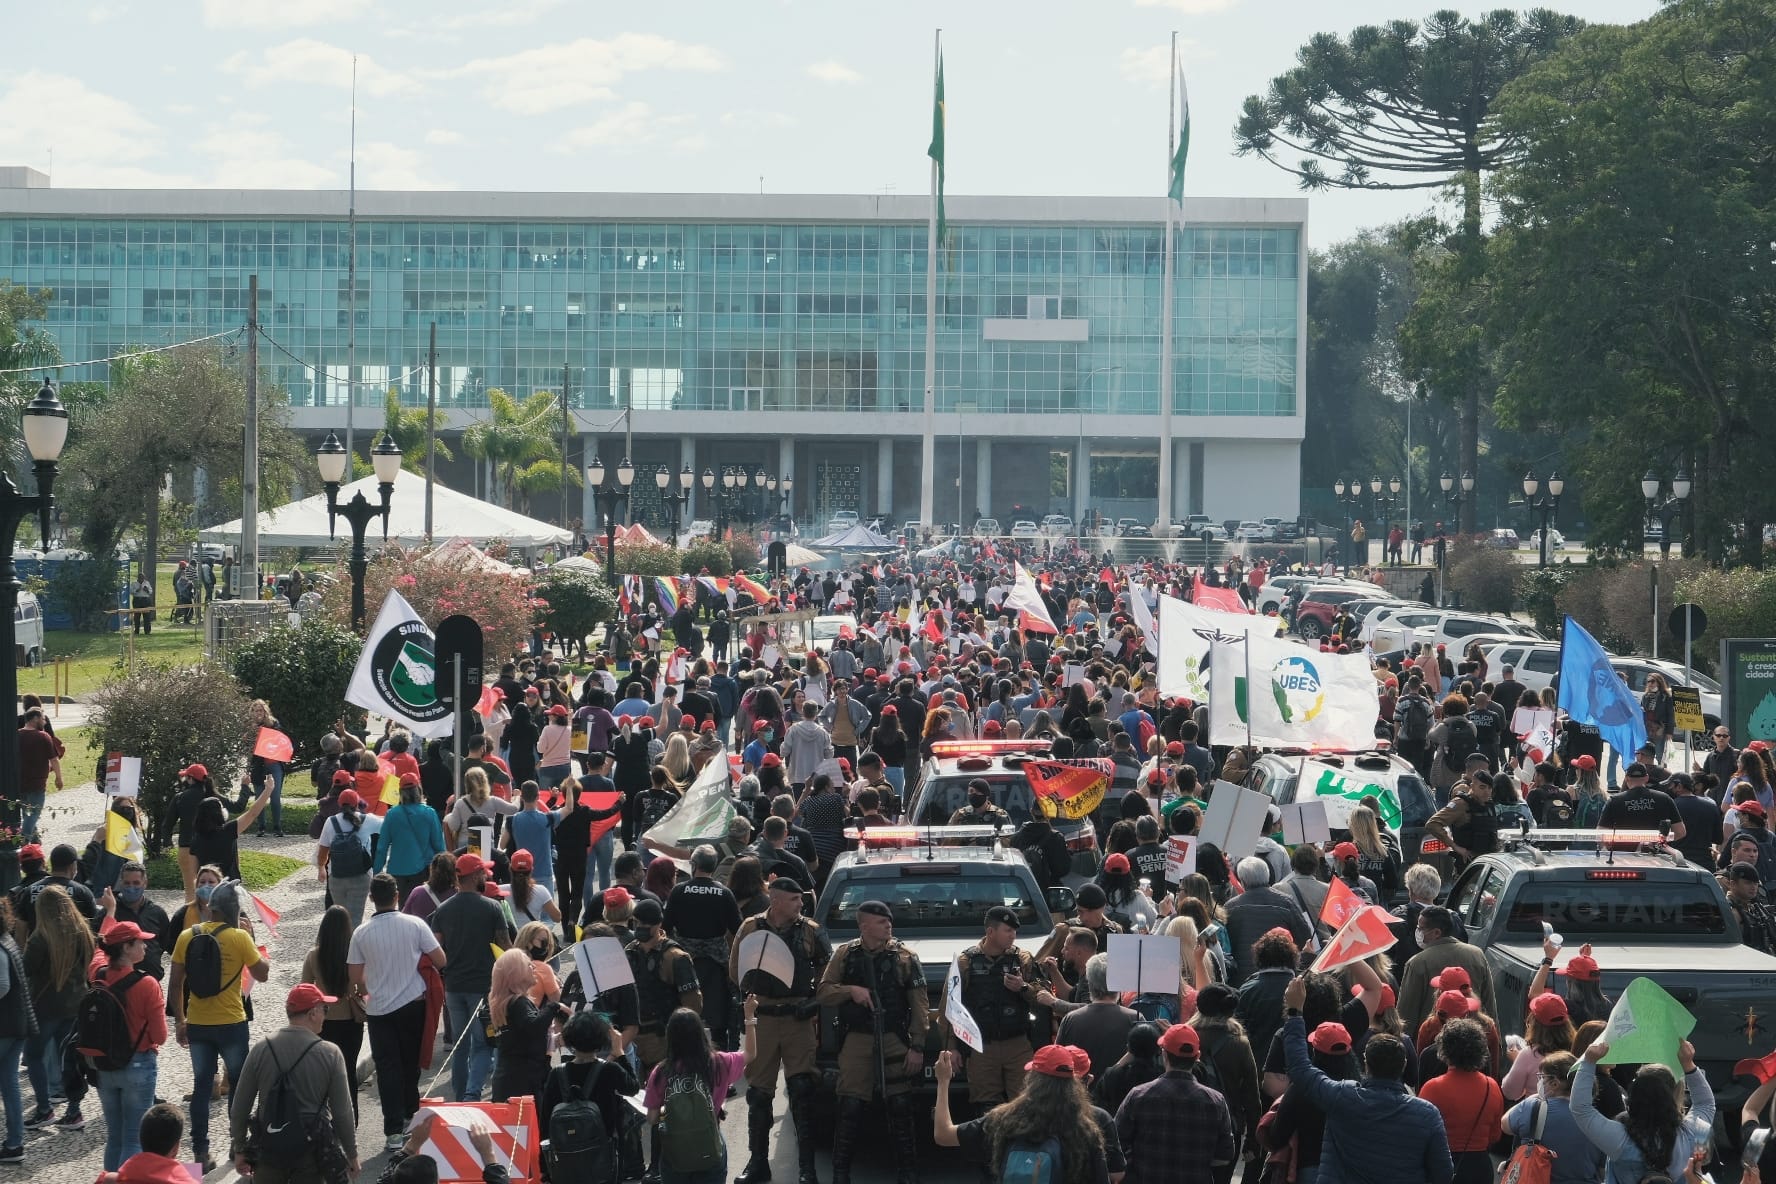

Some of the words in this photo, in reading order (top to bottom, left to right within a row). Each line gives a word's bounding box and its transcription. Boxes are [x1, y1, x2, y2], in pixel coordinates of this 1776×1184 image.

[1745, 670, 1775, 679] cidade
[1279, 673, 1318, 693] UBES
[1580, 726, 1599, 735] PENA
[946, 784, 1034, 814] RTA
[1627, 804, 1655, 812] PENAL
[1140, 862, 1167, 874] PENA
[683, 885, 723, 896] AGENTE
[1542, 894, 1684, 924] ROTAM
